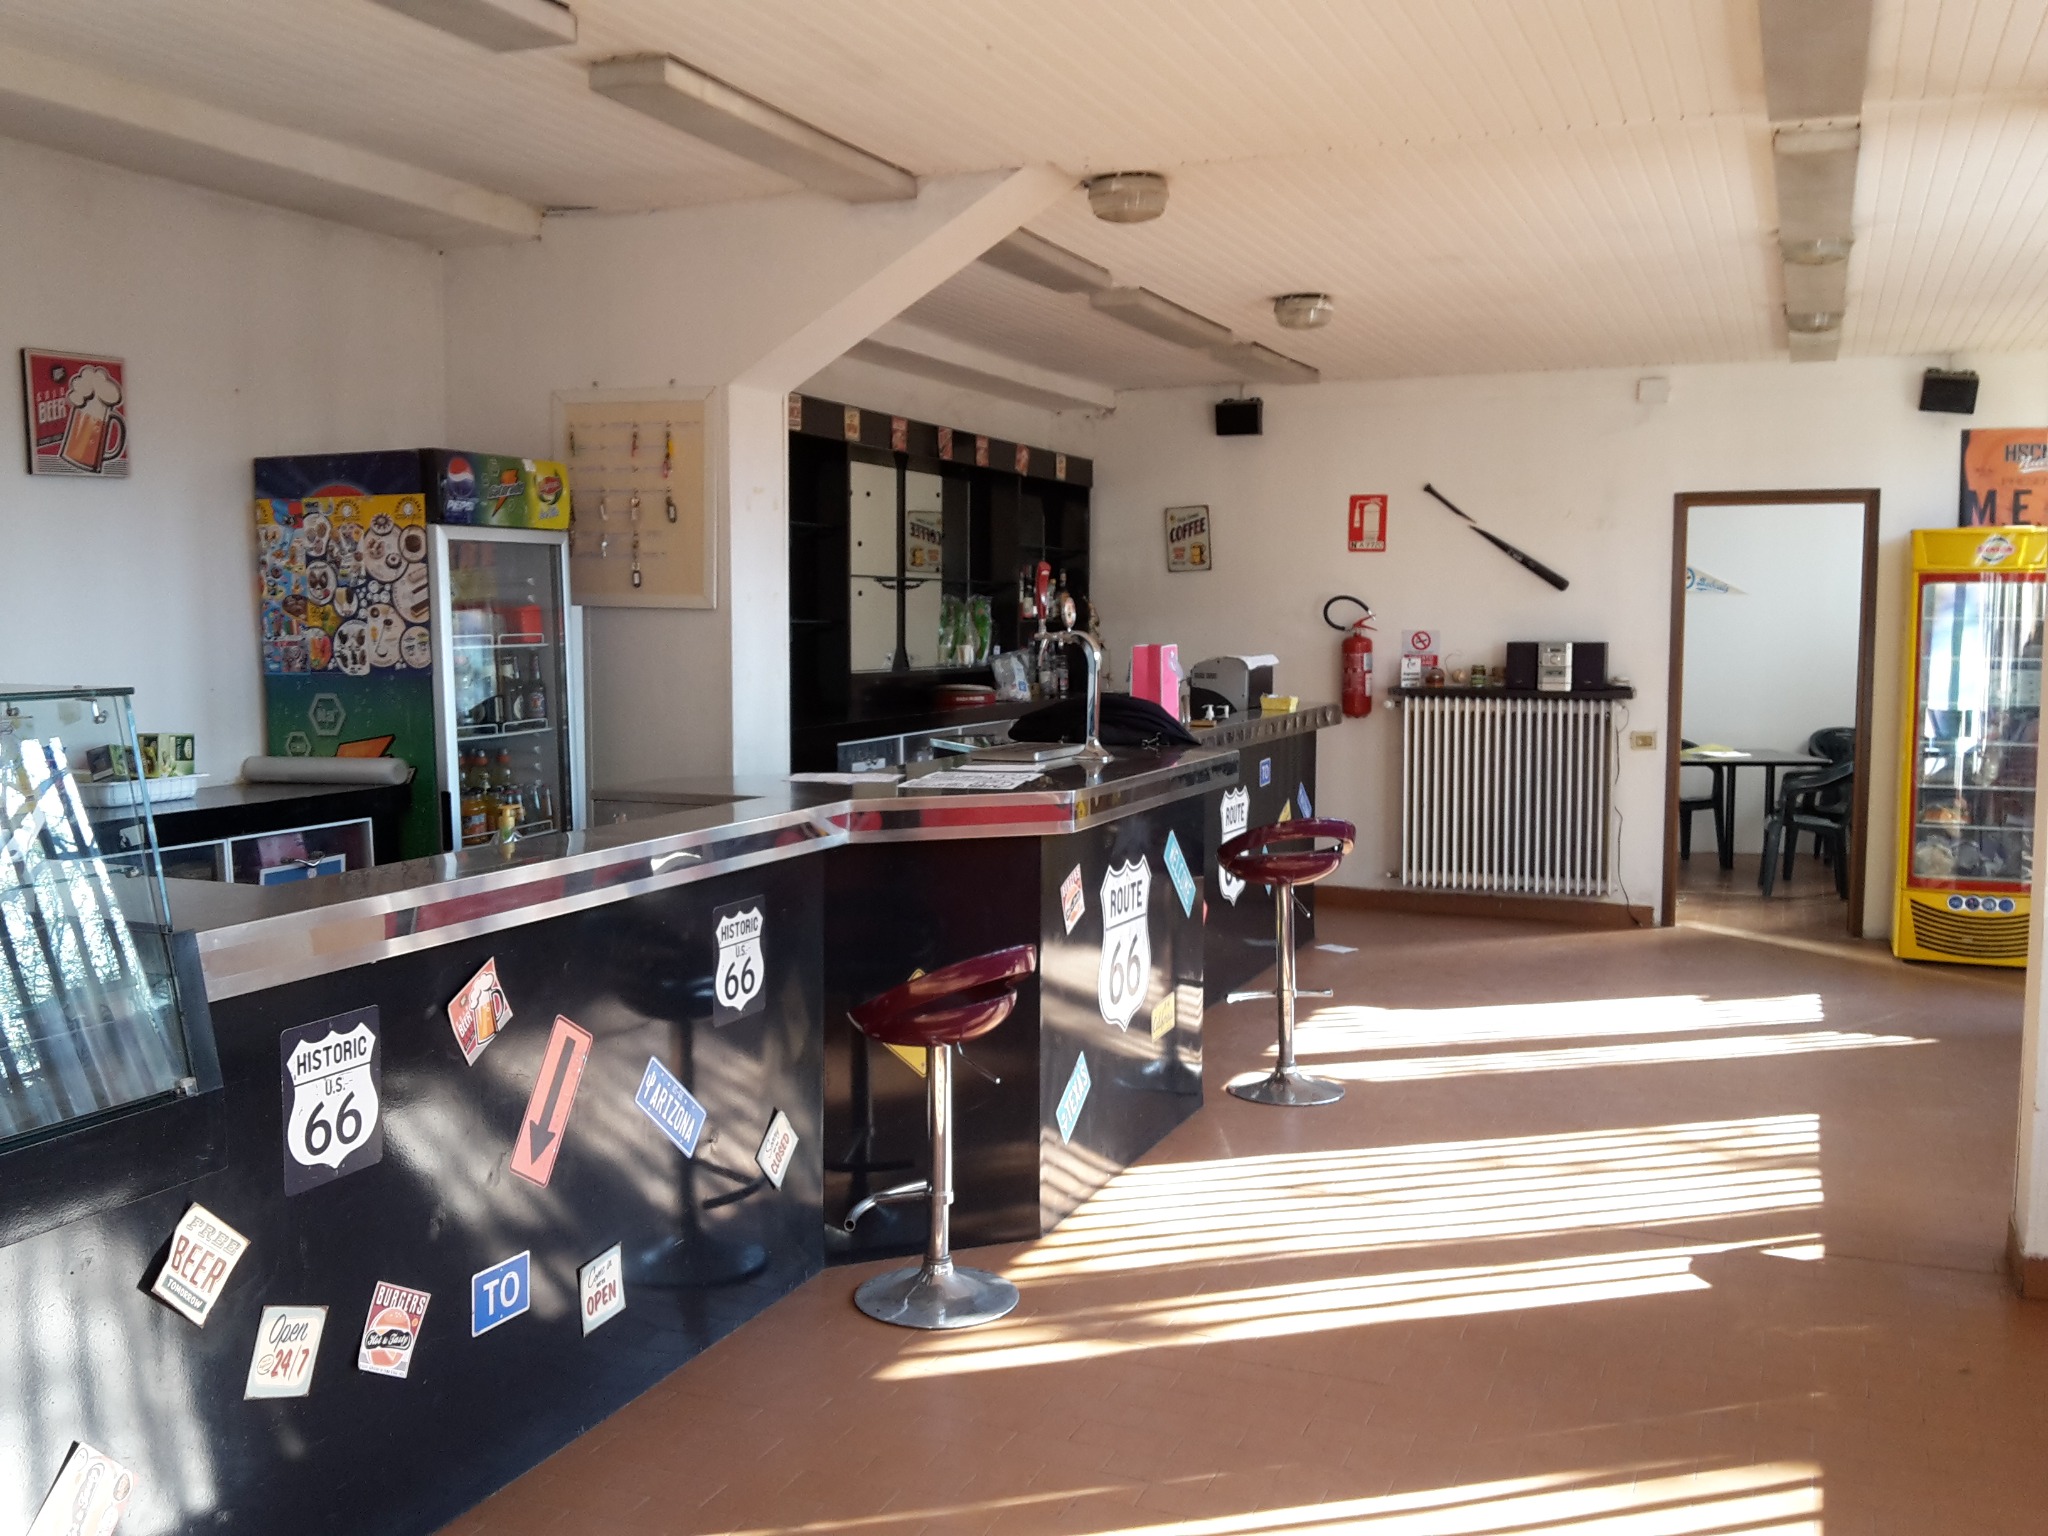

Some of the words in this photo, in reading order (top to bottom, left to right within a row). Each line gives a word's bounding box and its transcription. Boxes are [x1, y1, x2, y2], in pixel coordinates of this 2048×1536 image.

[39, 399, 67, 423] BEER
[1170, 517, 1205, 543] COFFEE
[1225, 802, 1245, 827] ROUTE
[1110, 879, 1143, 918] ROUTE
[721, 916, 759, 941] HISTORIC
[725, 956, 755, 1000] 66
[1109, 933, 1141, 1005] 66
[458, 1012, 473, 1038] BEER
[297, 1036, 367, 1076] HISTORIC
[325, 1077, 346, 1096] U.S.
[1064, 1064, 1088, 1122] TEXAS
[305, 1091, 362, 1156] 66
[650, 1083, 696, 1143] ARIZONA
[771, 1133, 790, 1175] CLOSED
[186, 1215, 241, 1257] FREE
[171, 1234, 227, 1294] BEER
[167, 1278, 203, 1310] TOMORROW
[376, 1285, 427, 1315] BURGERS
[483, 1271, 520, 1316] TO
[587, 1279, 617, 1317] OPEN
[269, 1313, 309, 1353] Open
[270, 1345, 310, 1381] 24/7
